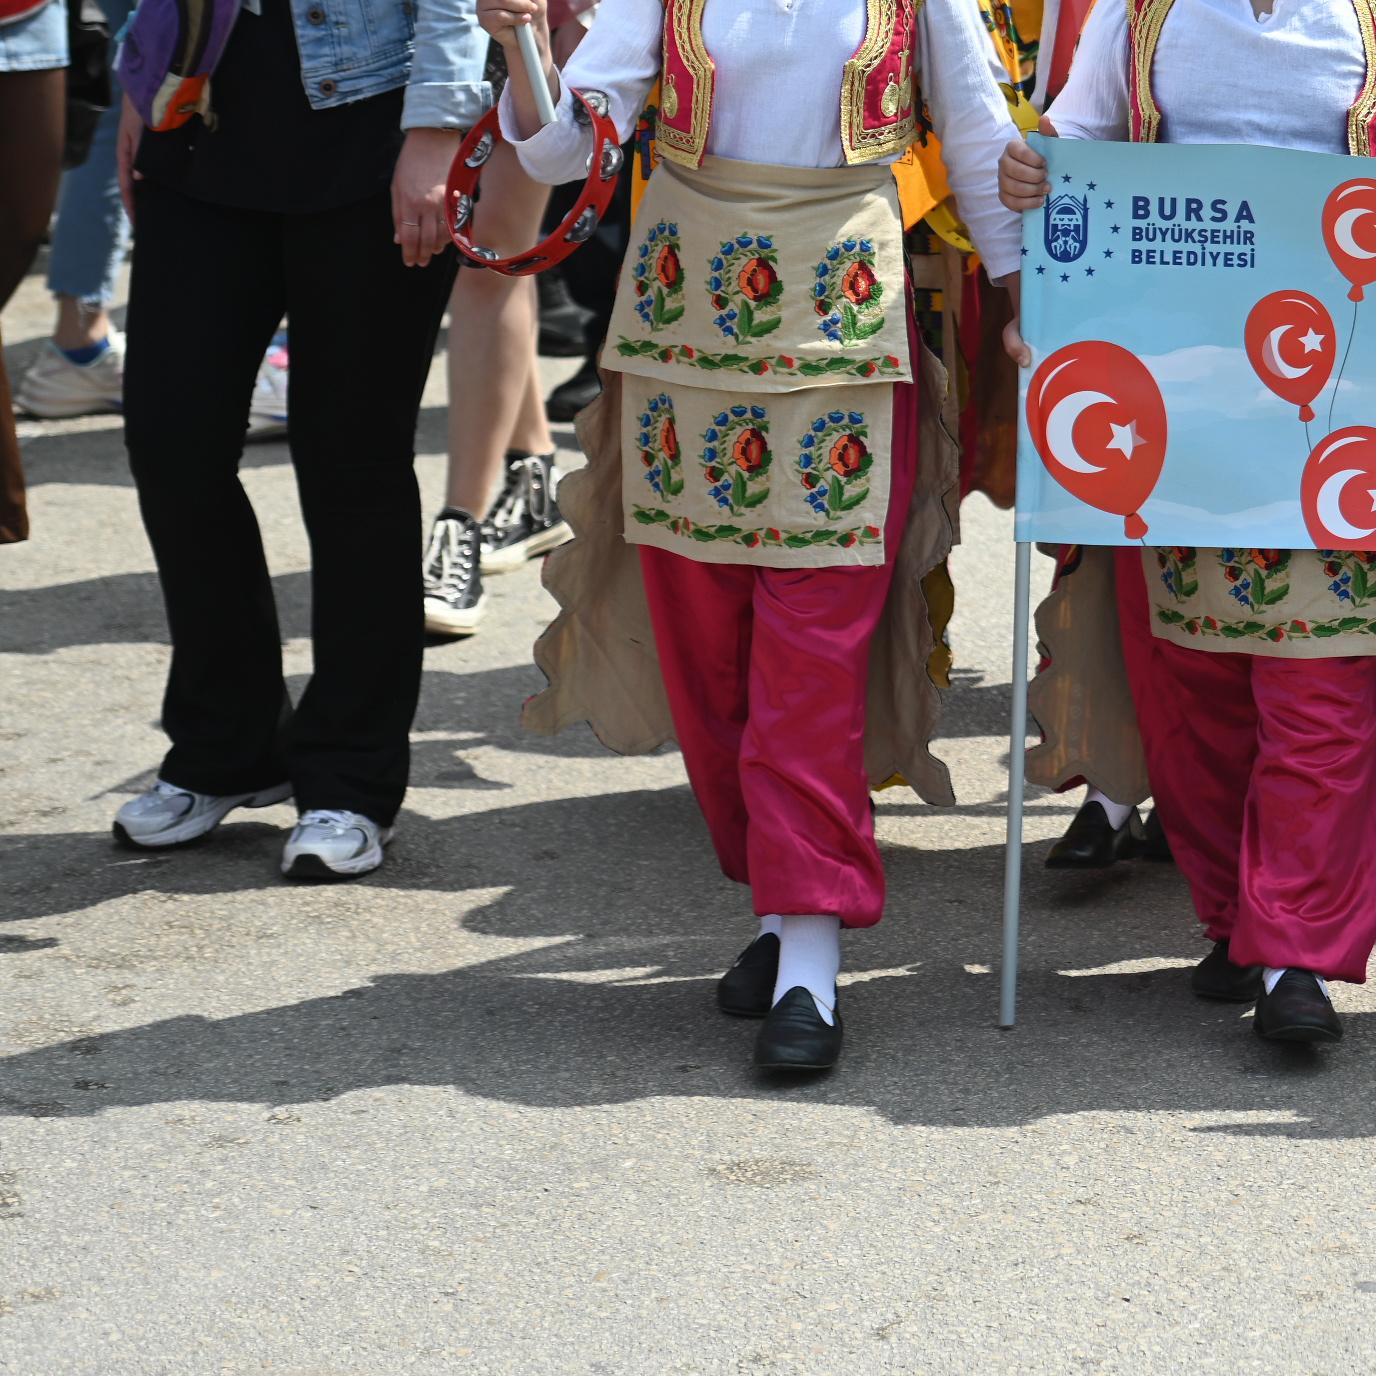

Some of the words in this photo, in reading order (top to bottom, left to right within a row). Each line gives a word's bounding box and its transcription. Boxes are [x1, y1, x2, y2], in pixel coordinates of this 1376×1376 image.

[1131, 195, 1256, 224] BURSA
[1131, 223, 1255, 247] BÜYÜKŞEHİR
[1130, 245, 1256, 269] BELEDİYESİ
